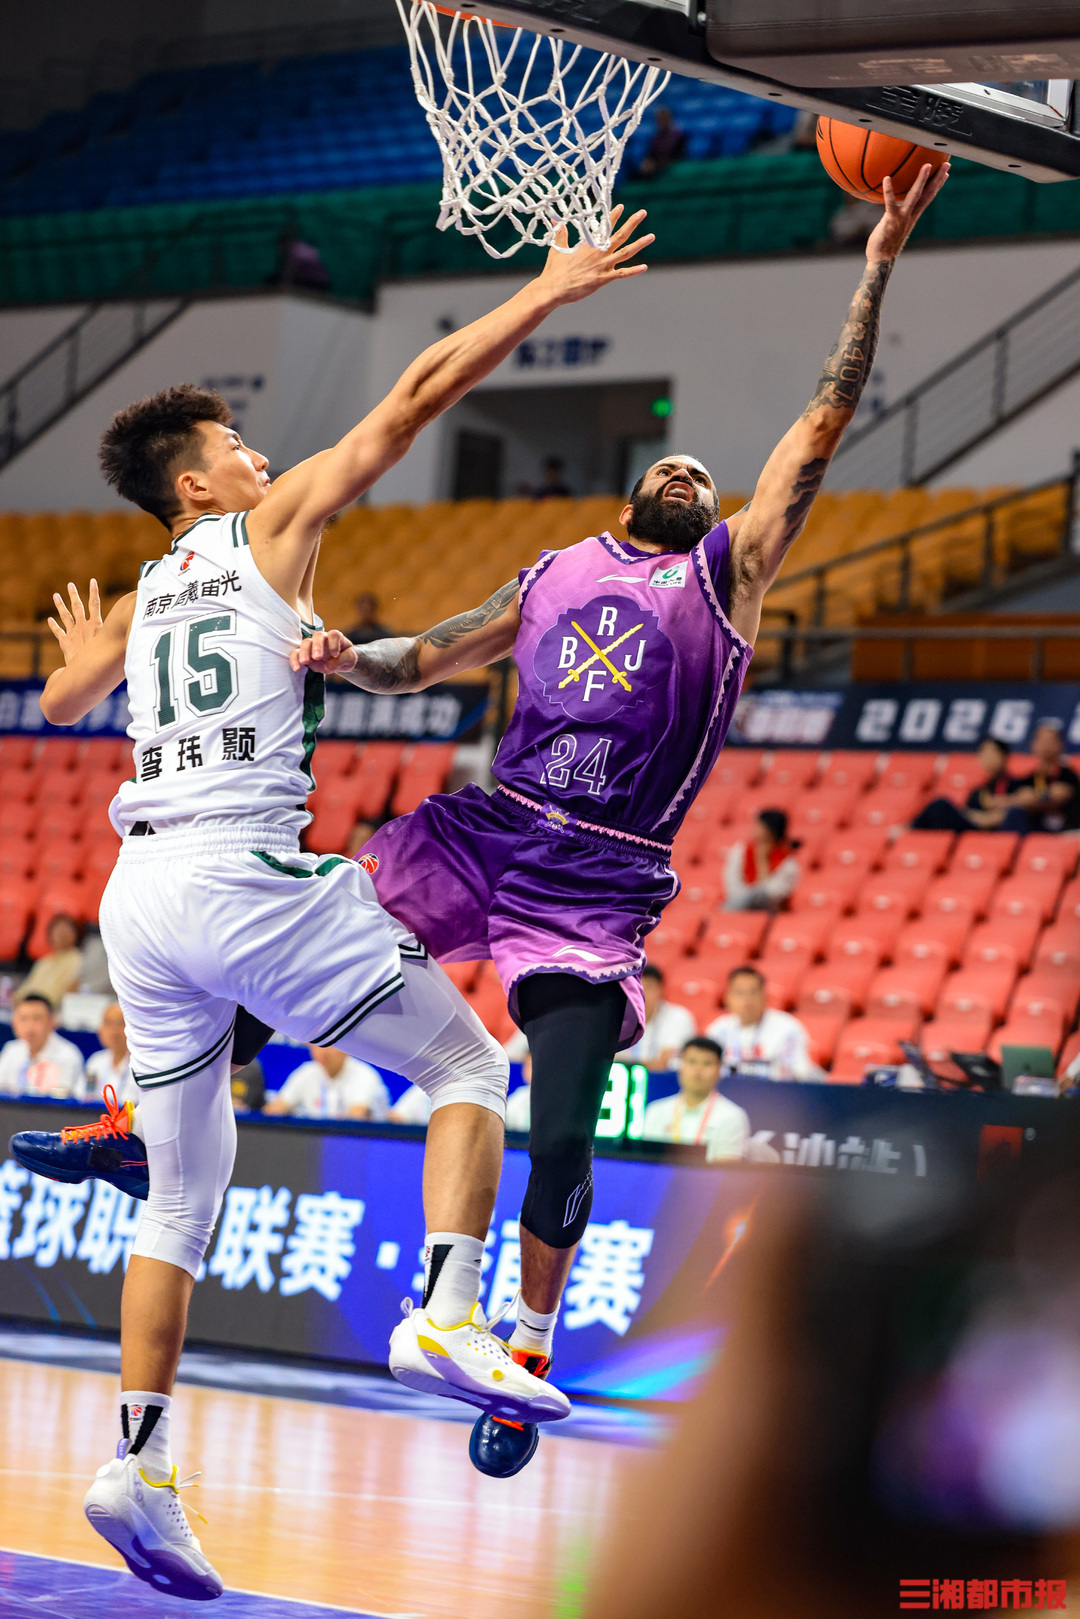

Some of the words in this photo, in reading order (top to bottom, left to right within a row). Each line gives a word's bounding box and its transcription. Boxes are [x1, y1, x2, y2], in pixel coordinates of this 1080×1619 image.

[596, 606, 618, 636] R
[557, 636, 578, 669] B
[624, 639, 647, 671] J
[149, 609, 239, 734] 15
[582, 670, 607, 702] F
[540, 733, 612, 795] 24
